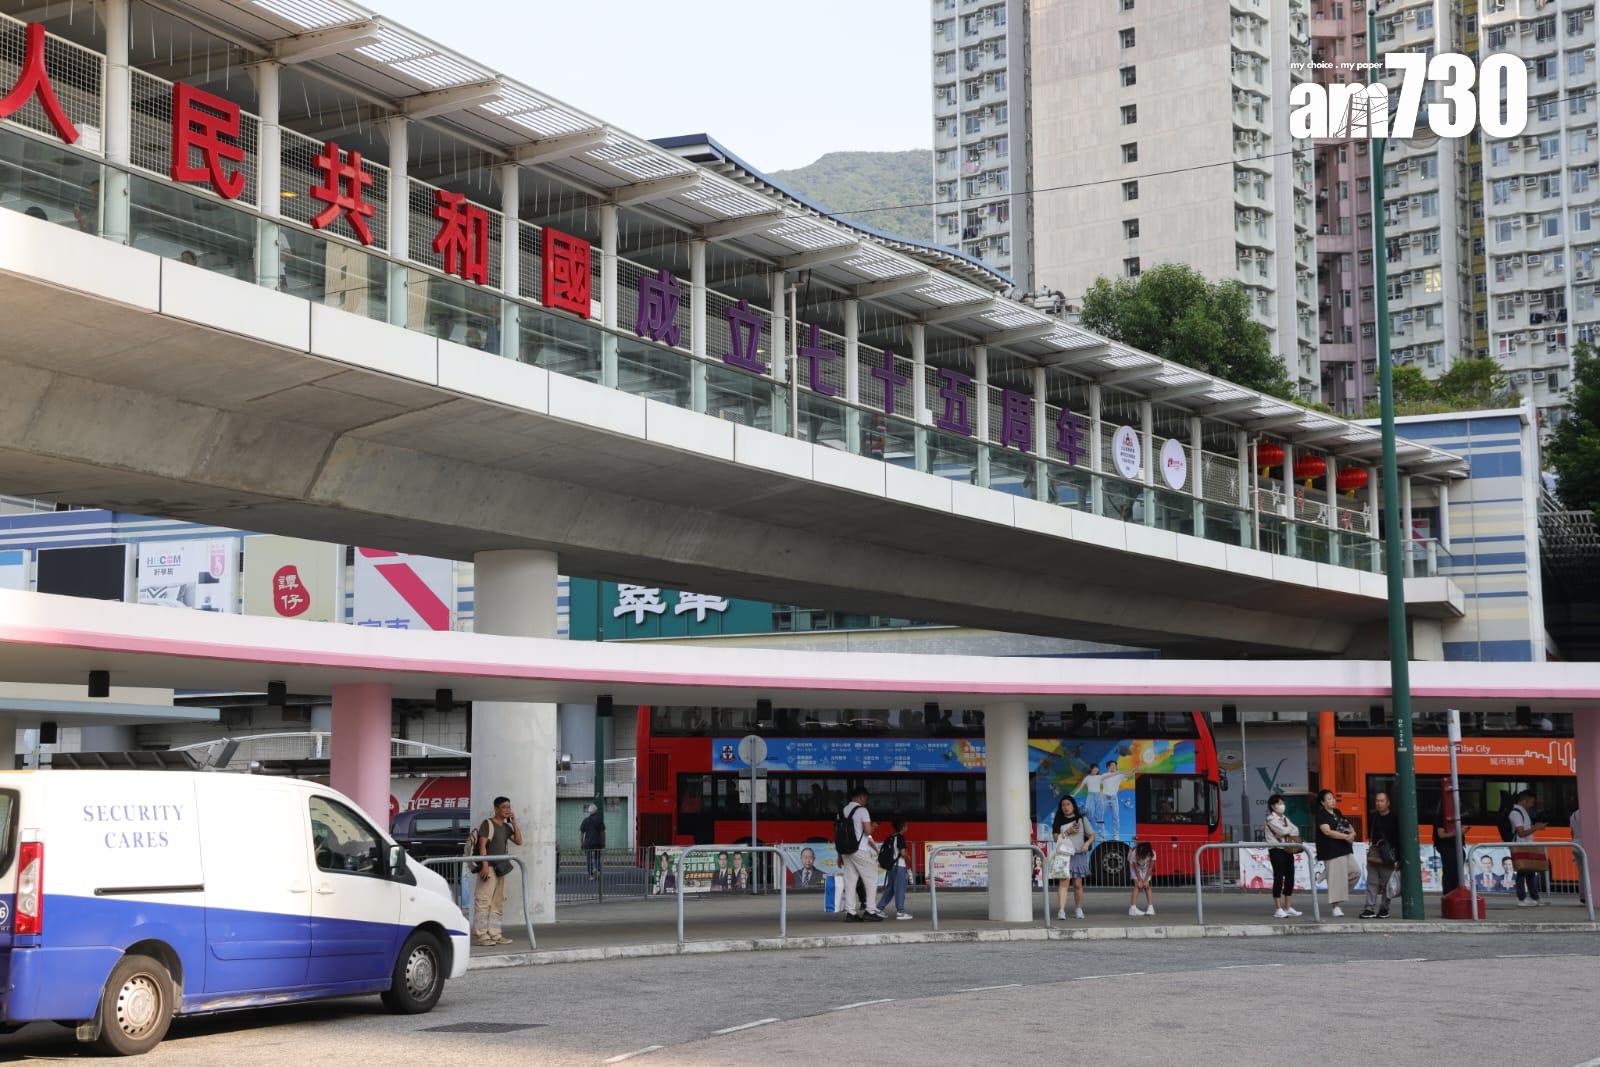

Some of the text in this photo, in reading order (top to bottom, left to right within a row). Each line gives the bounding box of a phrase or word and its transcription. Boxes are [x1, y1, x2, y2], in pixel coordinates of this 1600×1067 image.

[1475, 743, 1491, 755] City
[83, 804, 184, 822] SECURITY
[104, 831, 169, 849] CARES
